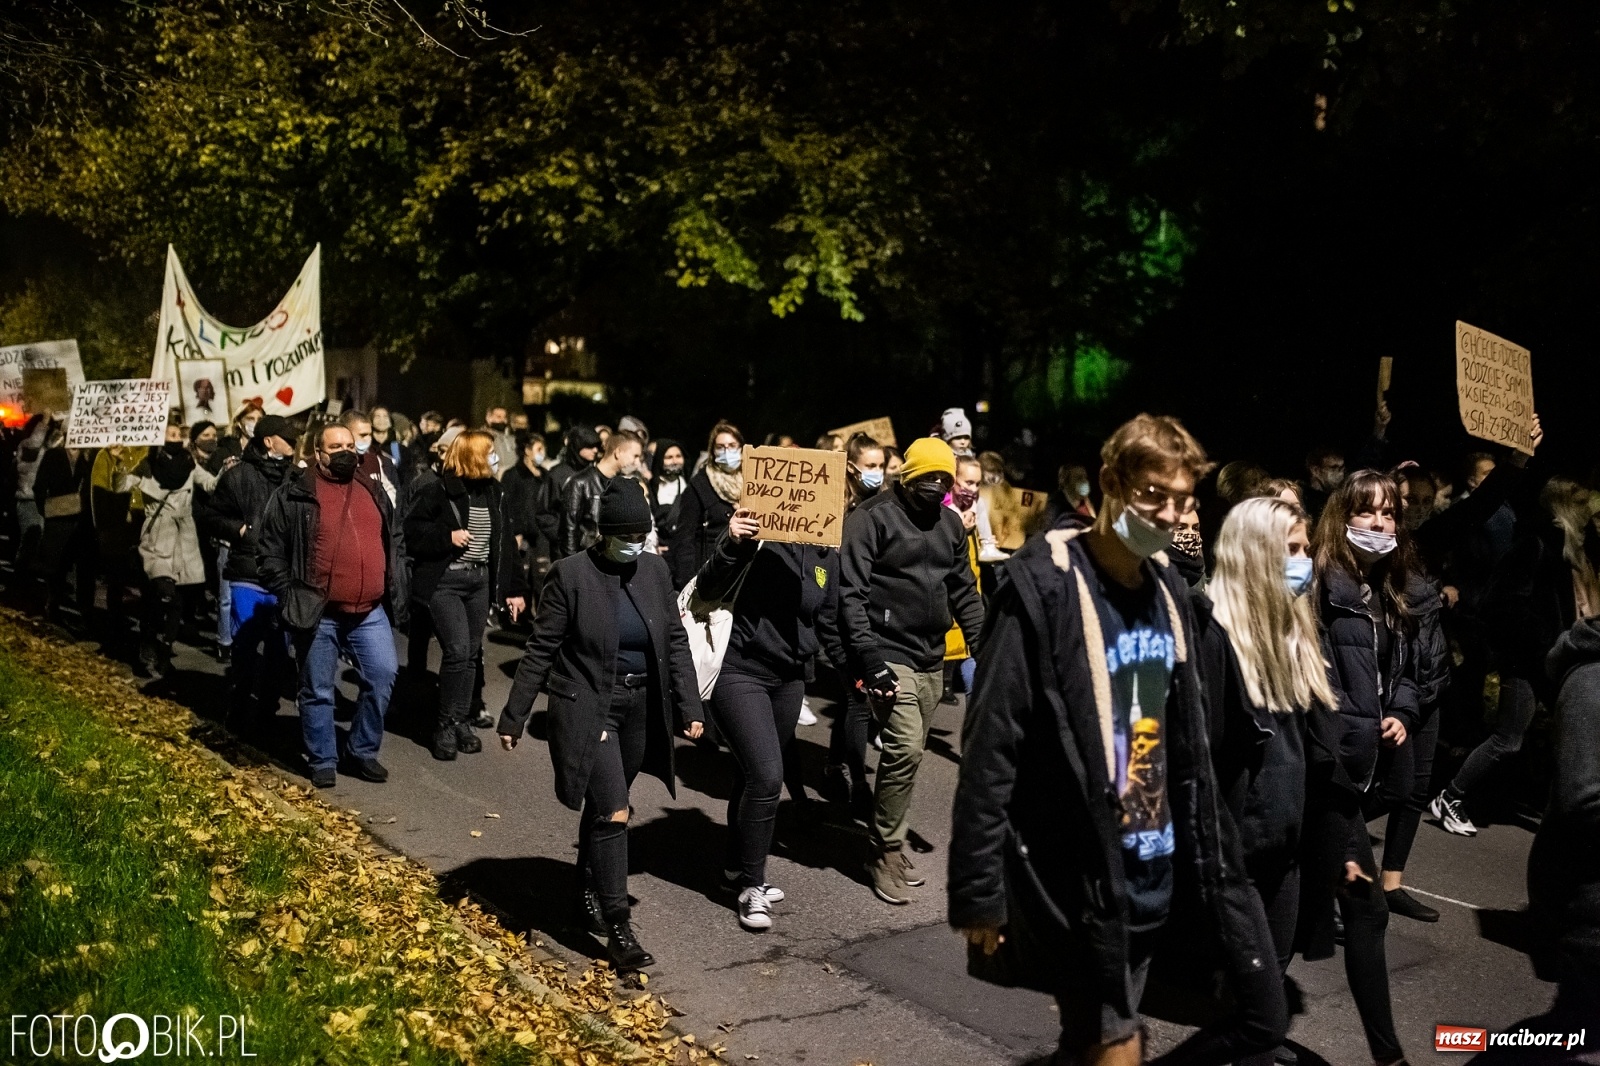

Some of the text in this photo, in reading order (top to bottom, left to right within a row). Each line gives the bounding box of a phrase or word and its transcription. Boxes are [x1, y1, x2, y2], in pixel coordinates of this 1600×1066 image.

[79, 382, 127, 394] WITAMY
[130, 382, 137, 391] W
[77, 396, 92, 406] TU
[144, 393, 168, 402] JEST
[75, 405, 155, 418] JAK ZARAZA
[69, 435, 101, 445] MEDIA
[116, 434, 148, 443] PRASA
[749, 456, 829, 485] TRZEBA
[746, 481, 815, 503] BYŁO NAS
[776, 501, 802, 512] NIE
